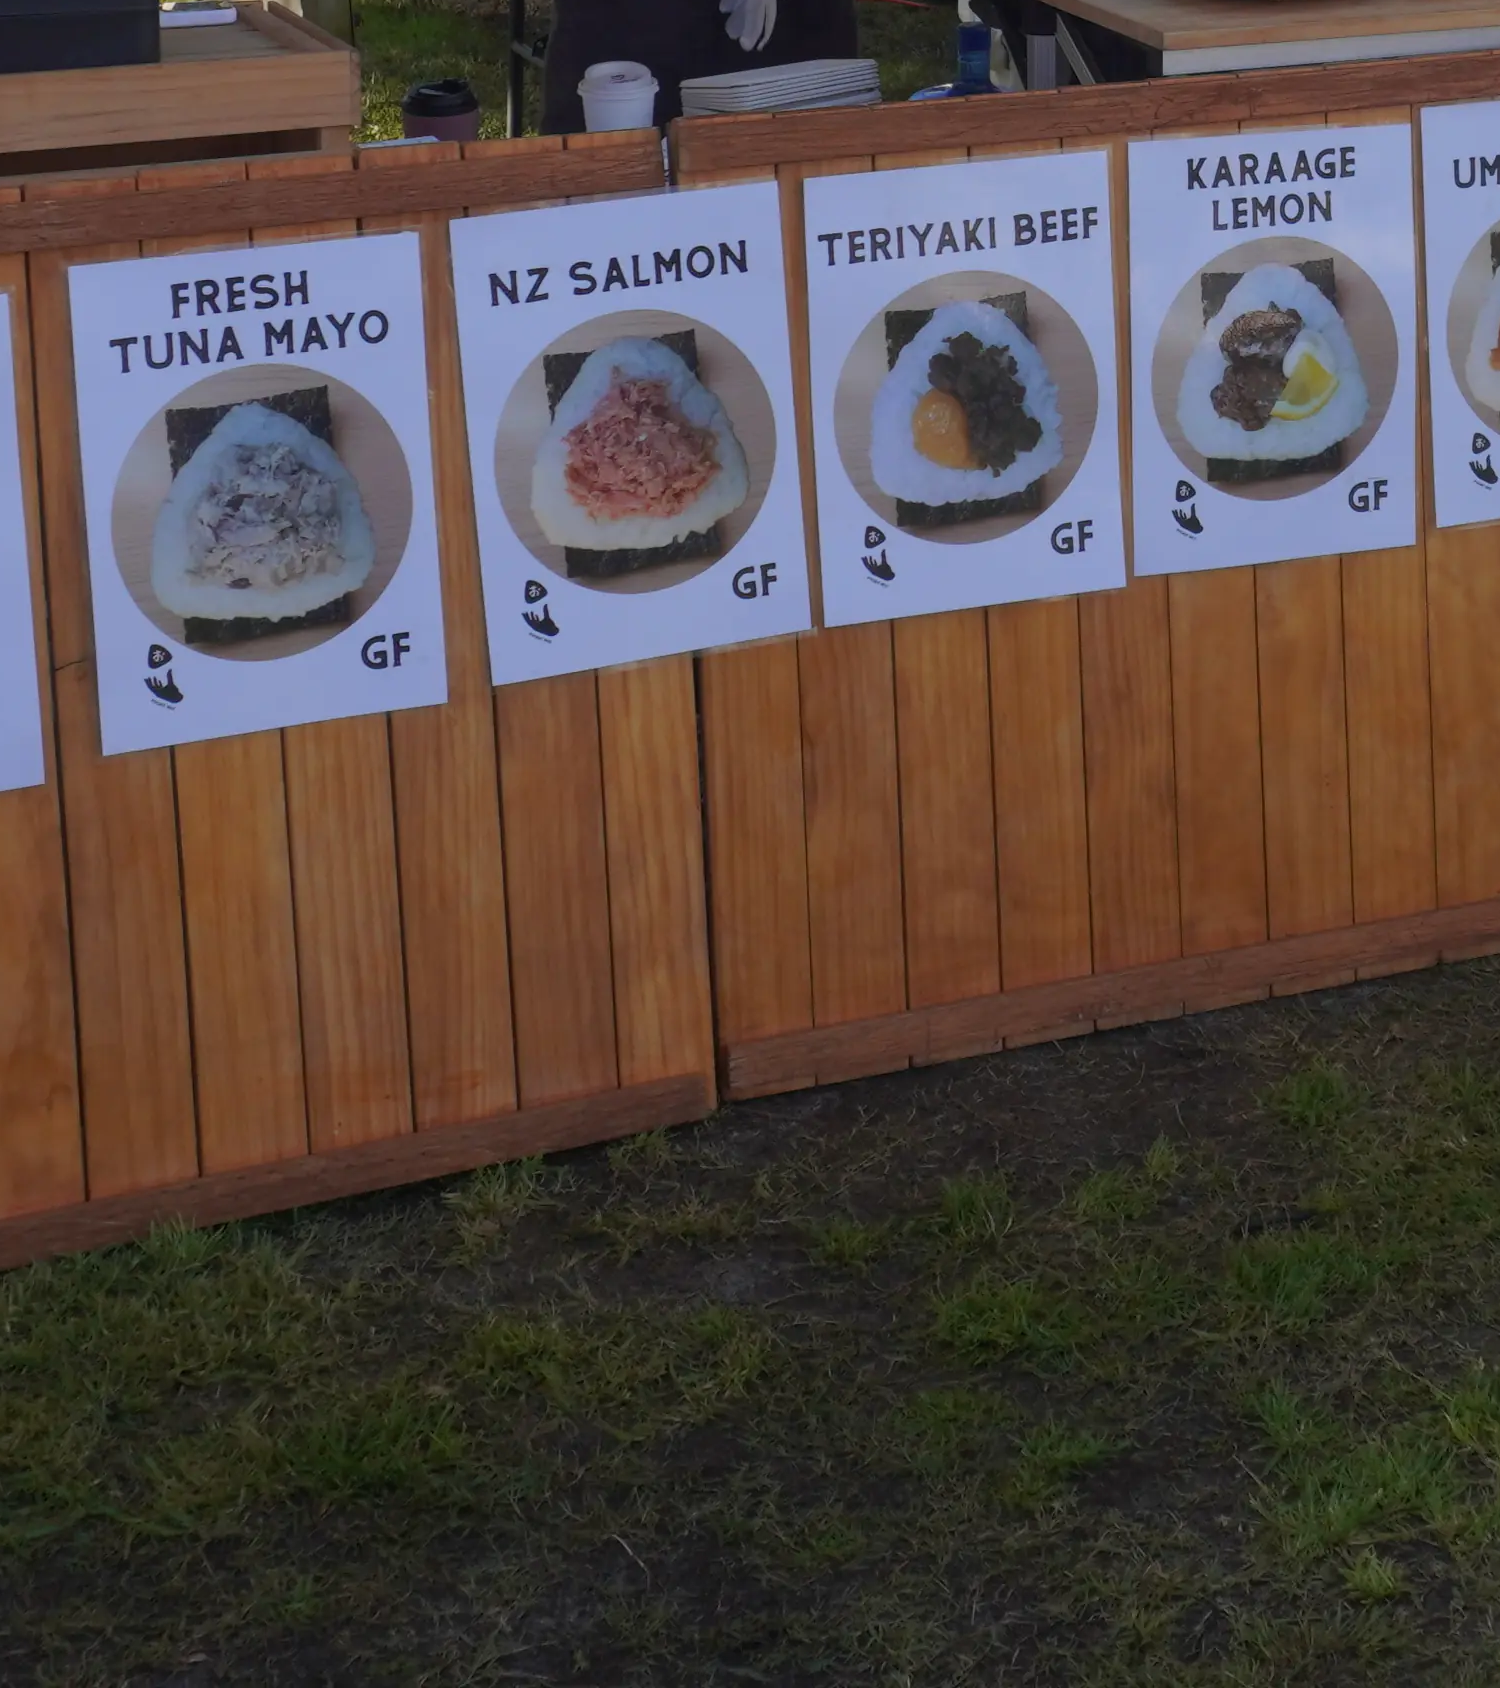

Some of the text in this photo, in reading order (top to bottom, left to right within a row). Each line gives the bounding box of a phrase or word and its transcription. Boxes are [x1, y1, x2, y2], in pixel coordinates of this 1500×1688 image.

[1186, 146, 1357, 191] KARAAGE
[1211, 191, 1333, 231] LEMON
[817, 206, 1099, 267] TERIYAKI BEEF
[170, 270, 310, 318] FRESH
[488, 240, 749, 307] NZ SALMON
[109, 310, 391, 374] TUNA MAYO
[1348, 479, 1389, 512] GF
[1050, 521, 1094, 554] GF
[732, 564, 778, 599] GF
[359, 631, 412, 671] GF
